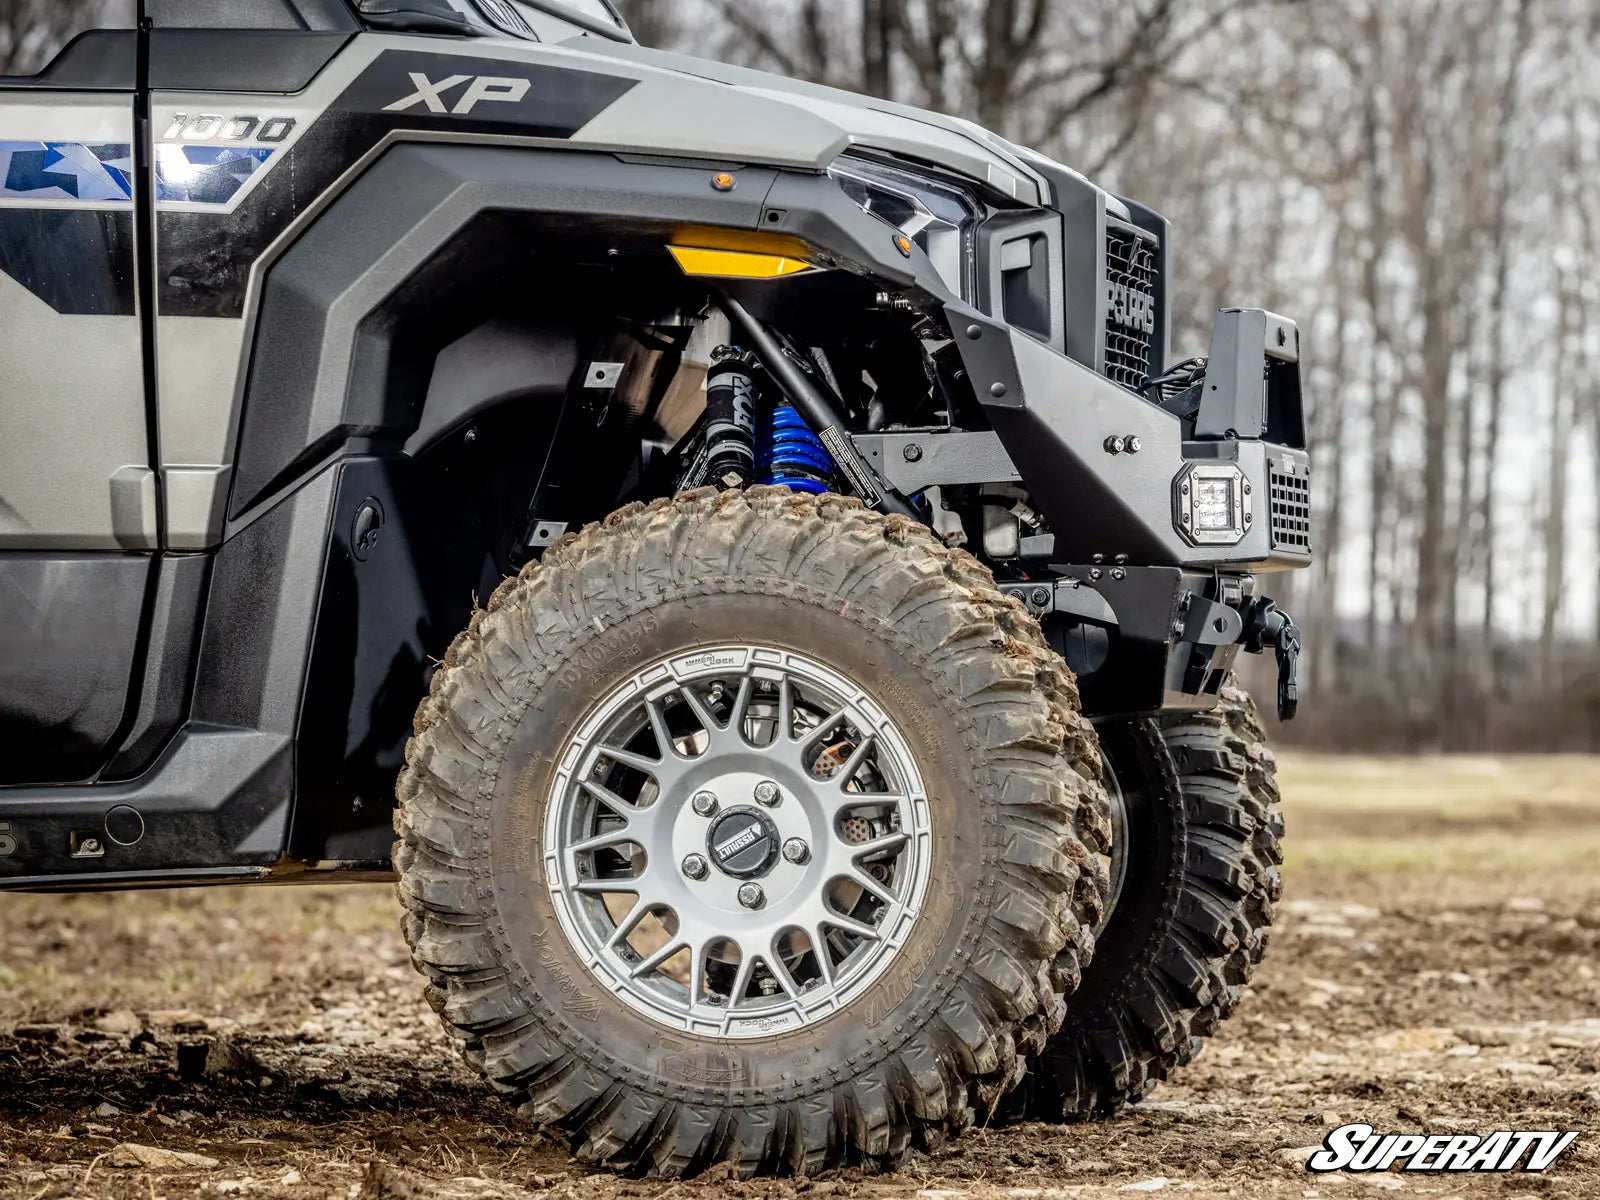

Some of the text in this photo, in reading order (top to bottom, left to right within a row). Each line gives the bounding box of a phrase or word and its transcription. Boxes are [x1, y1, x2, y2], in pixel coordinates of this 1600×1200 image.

[381, 72, 532, 114] XP
[162, 112, 298, 143] 1000
[718, 831, 756, 861] ASSAULT
[530, 927, 607, 1023] WARRIOR
